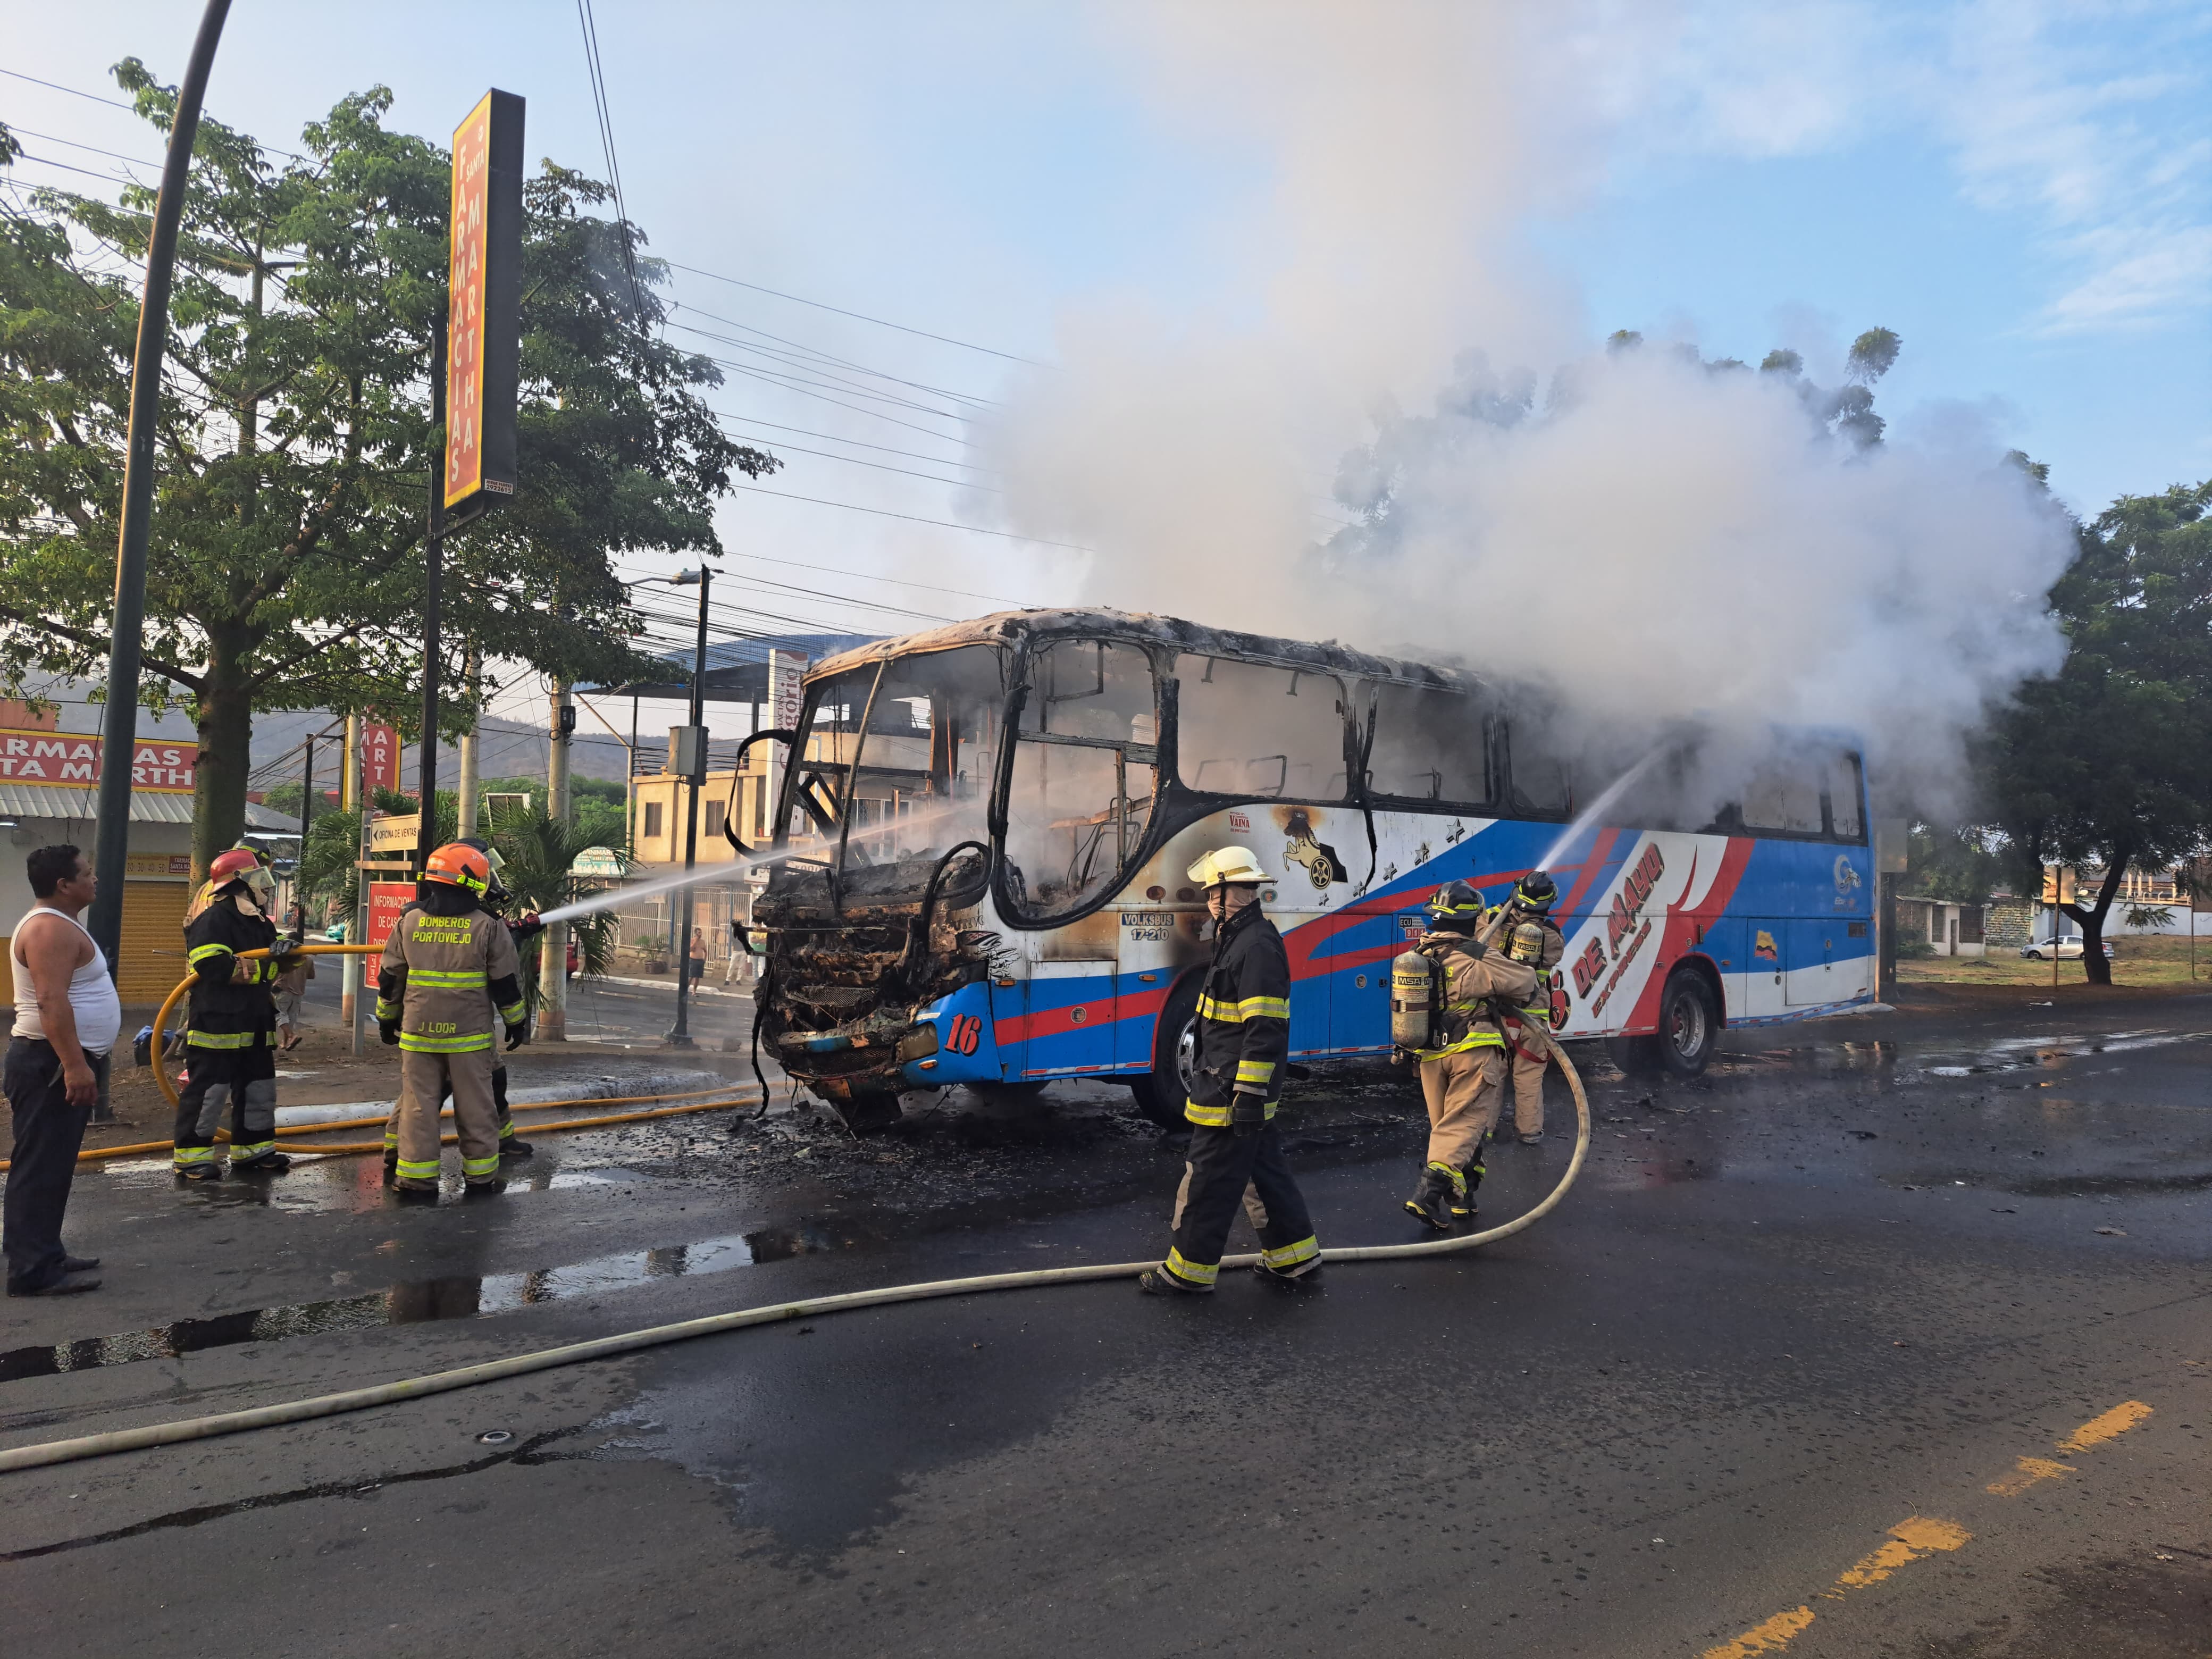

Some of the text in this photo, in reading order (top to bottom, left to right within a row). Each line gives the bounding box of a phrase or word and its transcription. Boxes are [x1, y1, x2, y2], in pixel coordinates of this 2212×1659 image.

[466, 148, 484, 183] SANTA
[451, 144, 466, 482] FARMACIAS
[463, 192, 480, 454] MARTHA
[486, 484, 512, 493] 2922615
[1229, 815, 1250, 828] VAINA
[379, 827, 417, 839] OFICINA DE VENTAS
[378, 916, 386, 928] DE
[418, 916, 472, 929] BOMBEROS
[1124, 914, 1172, 925] VOLKSBUS
[1571, 936, 1607, 999] DE
[1607, 842, 1665, 960] MAYO
[412, 931, 472, 944] PORTOVIEJO
[1131, 928, 1169, 941] 17-210
[1591, 918, 1652, 1019] EXPRESS
[418, 1021, 457, 1034] J LOOR
[944, 1012, 983, 1057] 16
